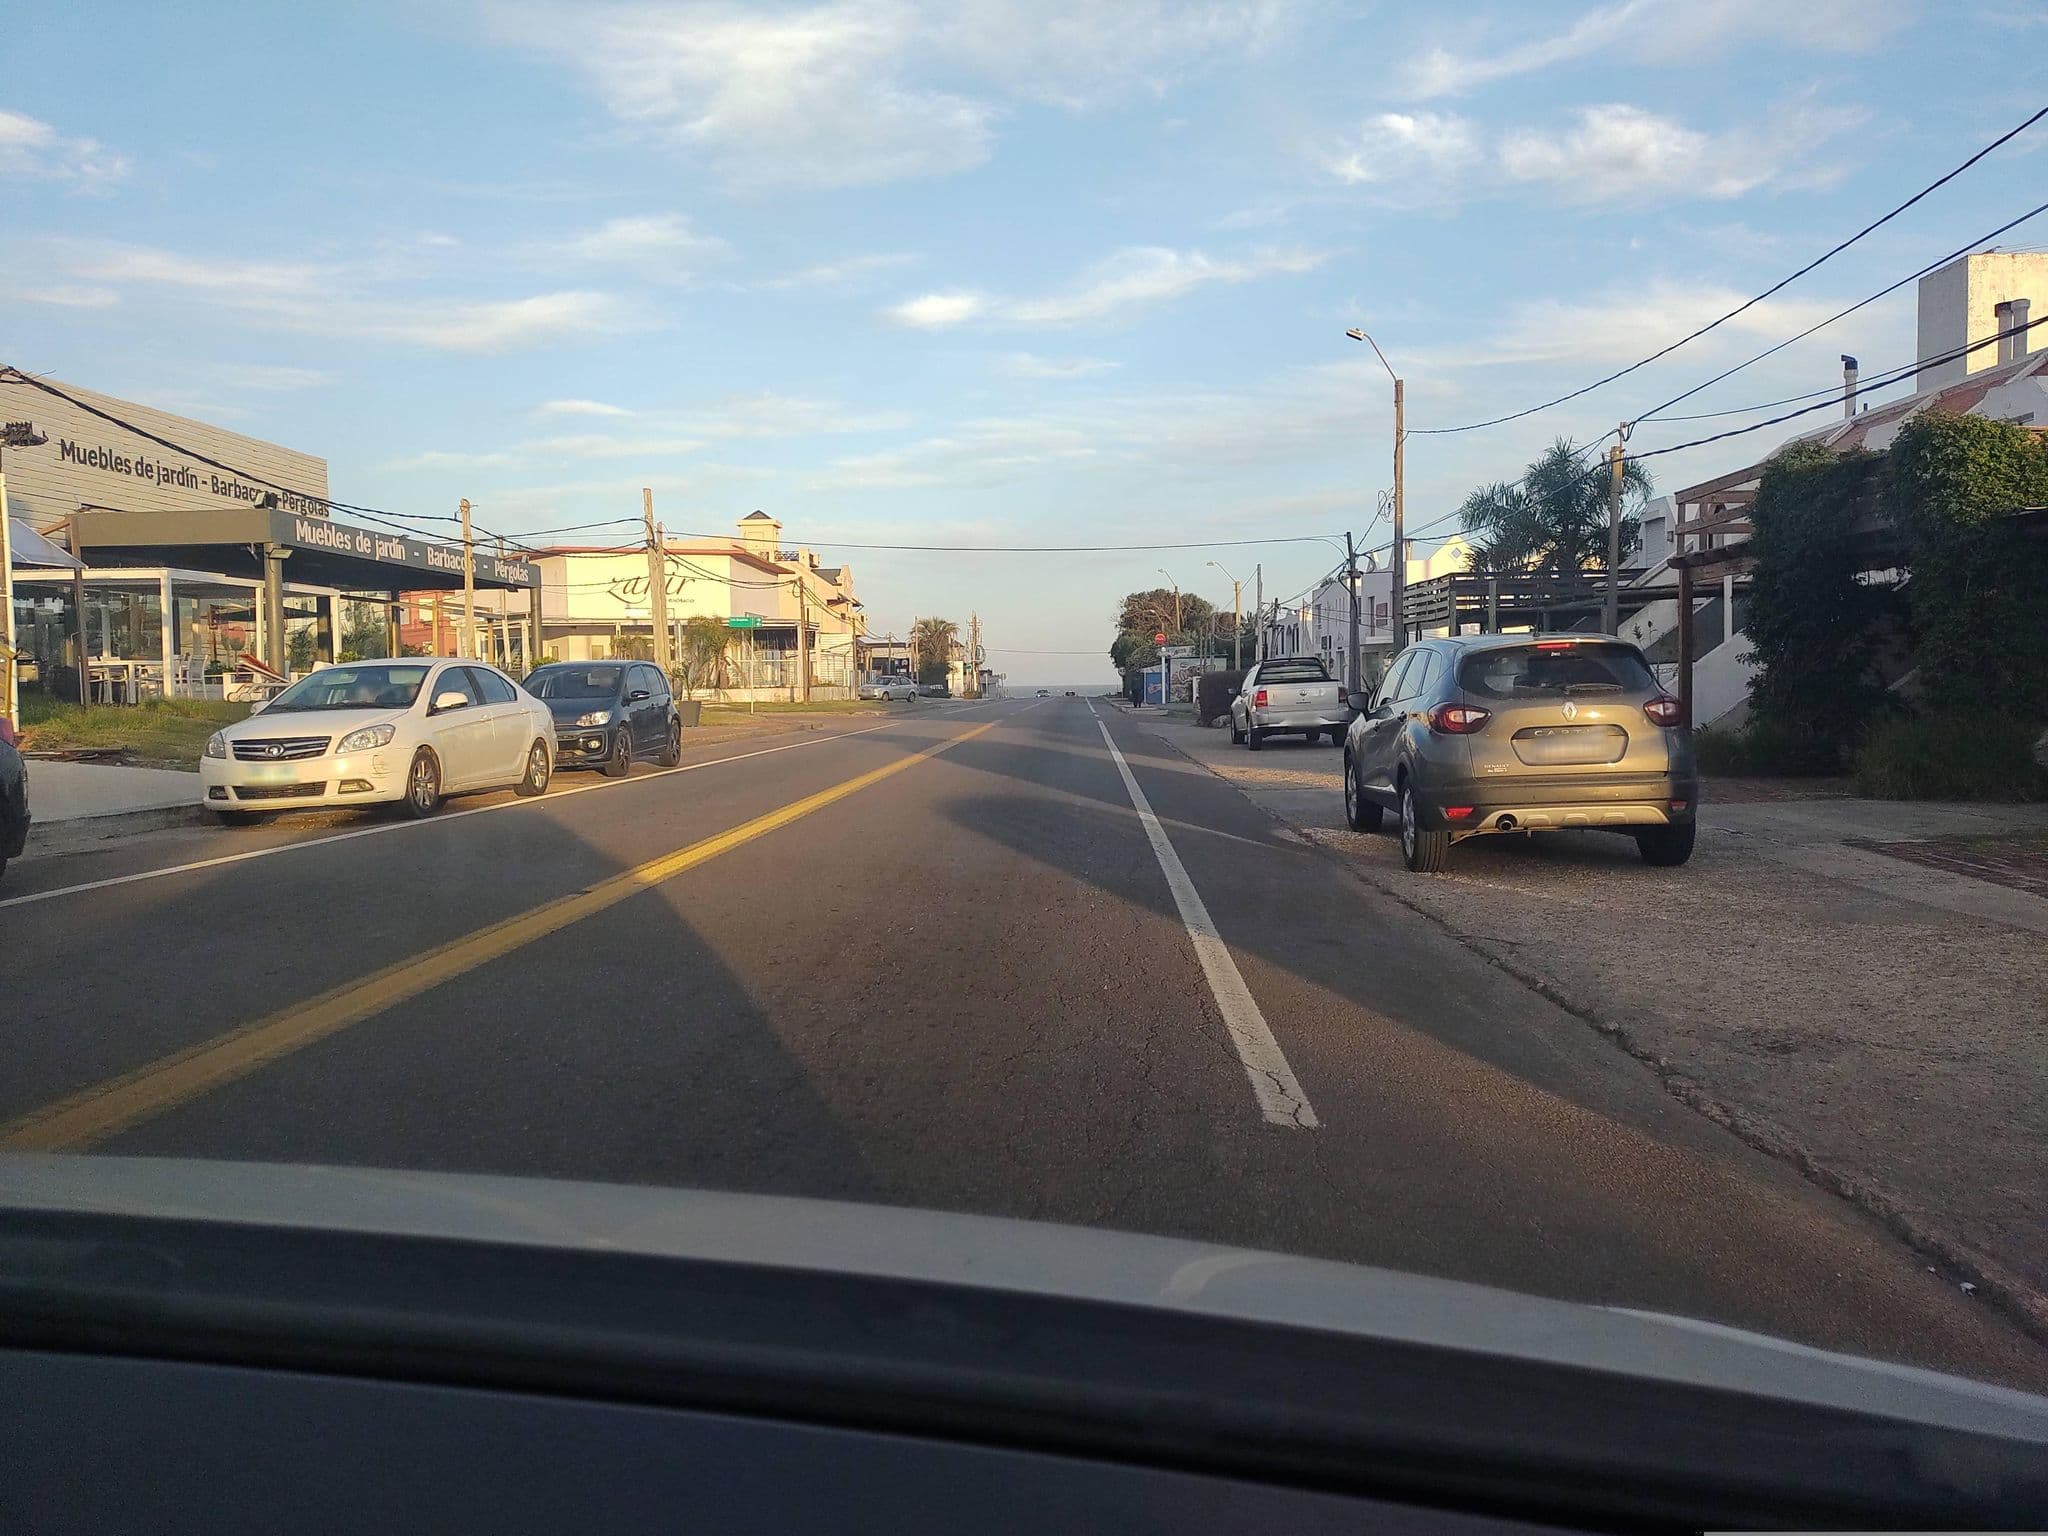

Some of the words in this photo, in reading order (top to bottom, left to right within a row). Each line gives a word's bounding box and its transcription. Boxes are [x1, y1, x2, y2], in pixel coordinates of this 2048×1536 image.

[60, 438, 132, 475] Muebles
[135, 456, 154, 480] de
[156, 460, 199, 489] jardín
[211, 474, 277, 504] Barbac
[295, 519, 352, 550] Muebles
[355, 530, 371, 554] de
[375, 534, 406, 560] jardín
[427, 546, 477, 573] Barbacos
[494, 559, 529, 583] Pérgolas
